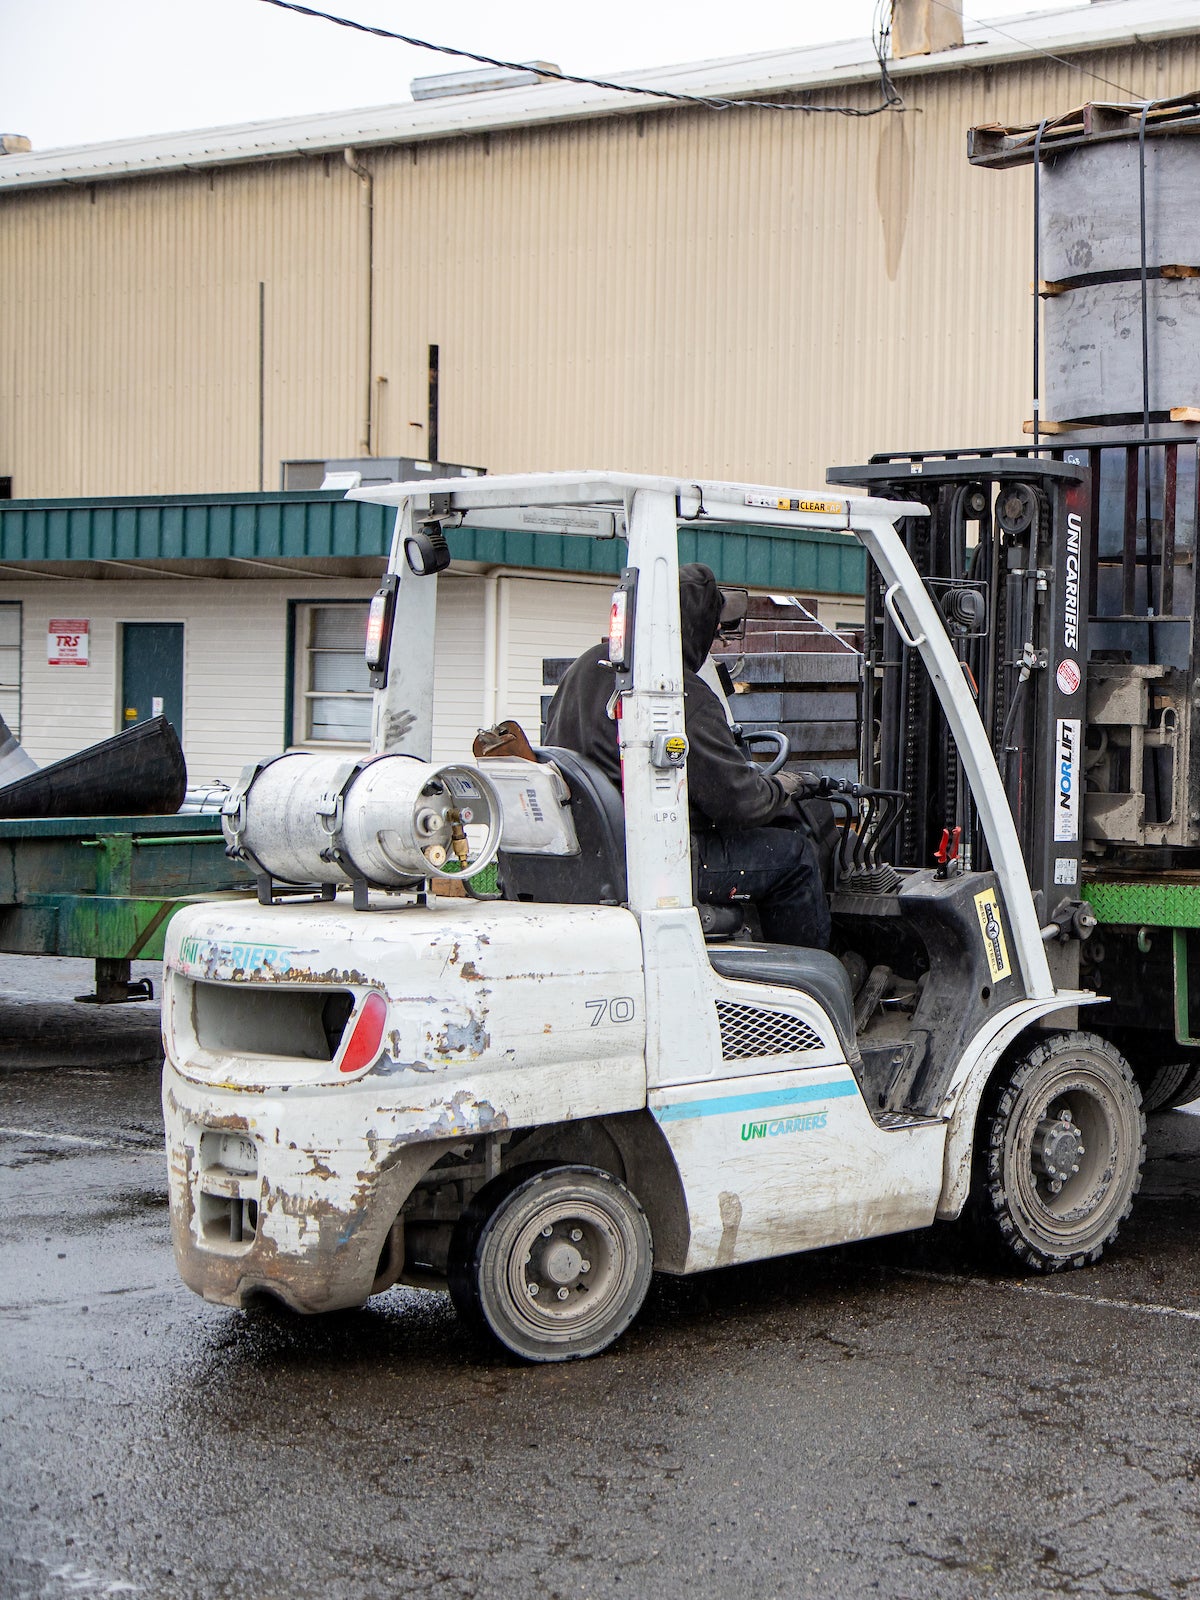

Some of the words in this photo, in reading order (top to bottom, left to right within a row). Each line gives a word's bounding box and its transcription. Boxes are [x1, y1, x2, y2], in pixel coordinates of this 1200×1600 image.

[1063, 512, 1082, 651] UNICARRIERS
[55, 635, 81, 647] TRS
[1060, 722, 1074, 810] NORLIFT
[584, 996, 635, 1027] 70
[740, 1111, 828, 1141] UNICARRIERS
